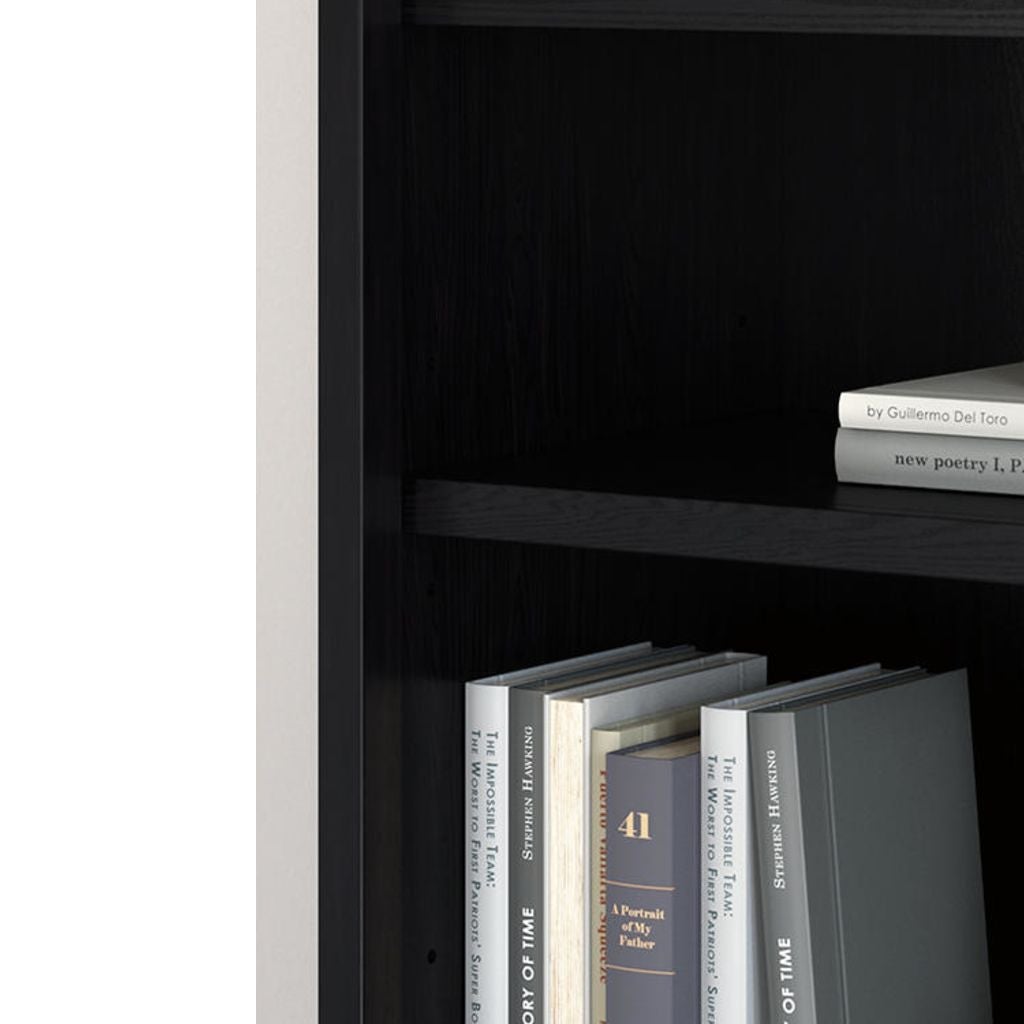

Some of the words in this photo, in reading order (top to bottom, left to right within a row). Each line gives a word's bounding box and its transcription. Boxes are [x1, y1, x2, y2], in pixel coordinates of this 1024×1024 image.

[867, 406, 883, 420] by
[887, 407, 950, 422] Guillermo
[954, 411, 976, 423] Del
[981, 412, 1008, 426] Toro
[895, 453, 929, 467] new
[933, 456, 988, 474] poetry
[472, 730, 482, 753] THE
[487, 732, 499, 755] THE
[522, 726, 534, 791] HAWKING
[708, 756, 719, 779] THE
[723, 757, 736, 781] THE
[472, 762, 482, 809] WORST
[767, 751, 781, 817] HAWKING
[486, 763, 499, 838] IMPOSSIBLE
[708, 788, 718, 836] WORST
[472, 817, 479, 832] TO
[522, 798, 534, 860] STEPHEN
[618, 812, 653, 840] 41
[723, 789, 737, 866] IMPOSSIBLE
[472, 840, 482, 872] FIRST
[487, 846, 499, 887] TEAM:
[708, 844, 716, 861] TO
[772, 824, 786, 888] STEPHEN
[708, 868, 719, 902] FIRST
[724, 874, 737, 917] TEAM:
[522, 908, 535, 948] TIME
[611, 904, 619, 915] A
[621, 904, 665, 920] Portrait
[619, 935, 656, 950] Father
[621, 921, 634, 932] of
[634, 922, 651, 937] My
[472, 955, 482, 995] SUPER
[522, 956, 535, 980] OF
[778, 939, 793, 980] TIME
[782, 988, 796, 1013] OF
